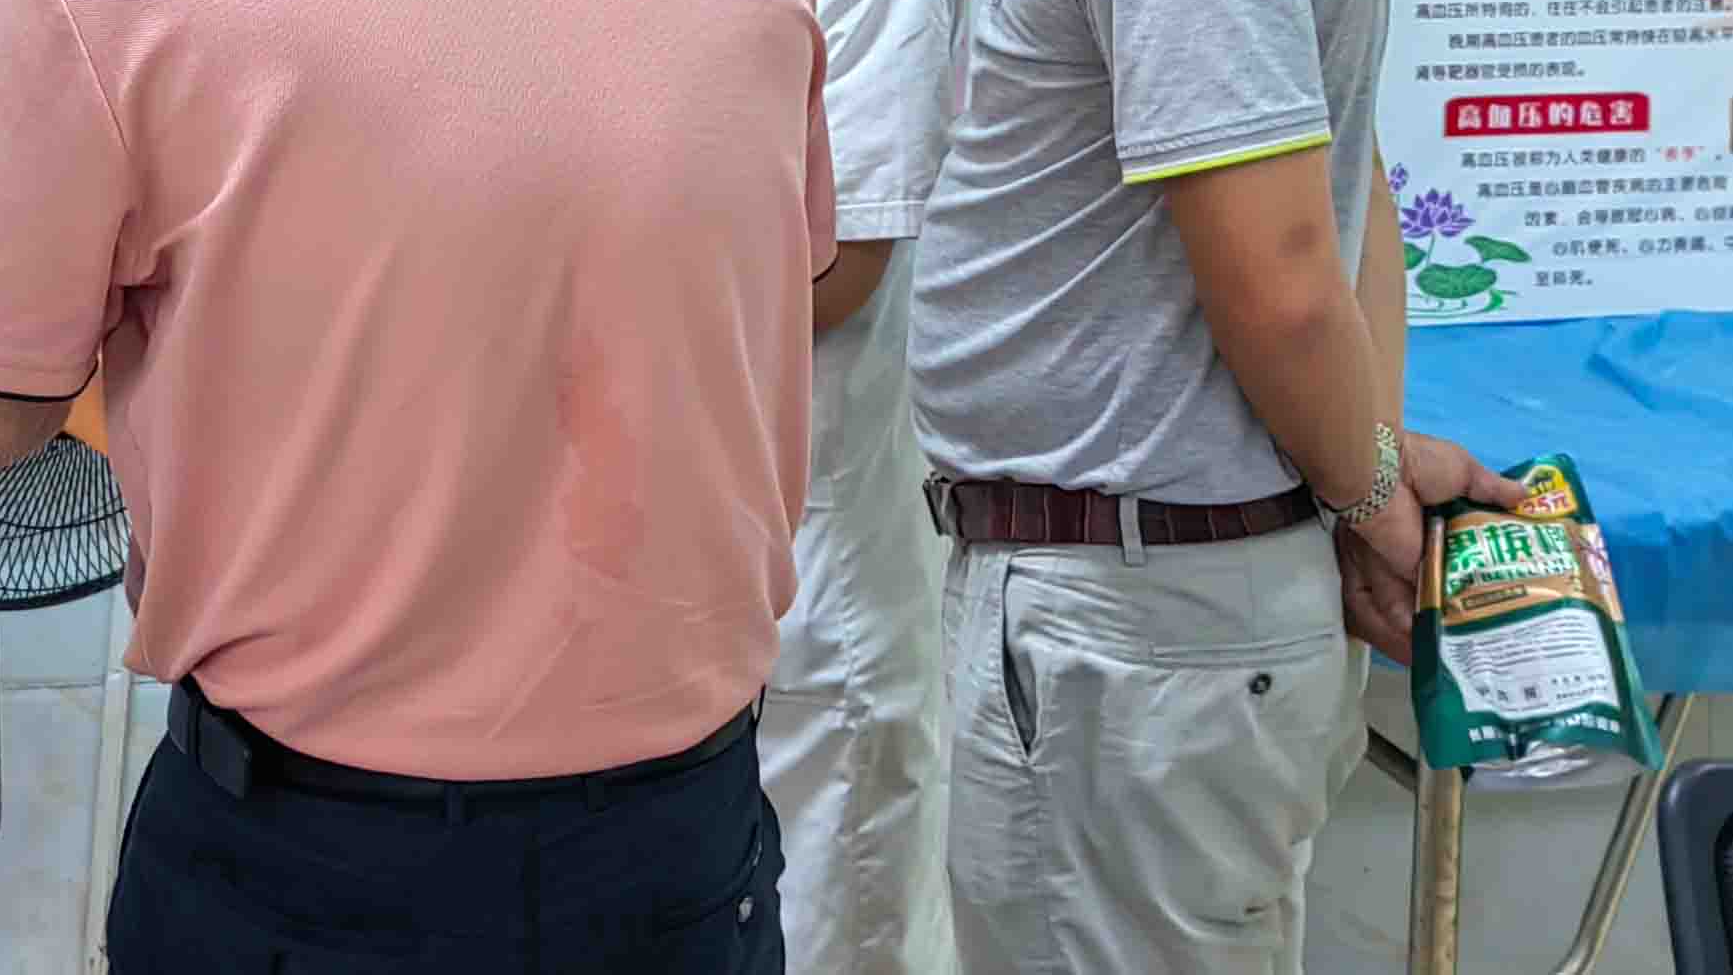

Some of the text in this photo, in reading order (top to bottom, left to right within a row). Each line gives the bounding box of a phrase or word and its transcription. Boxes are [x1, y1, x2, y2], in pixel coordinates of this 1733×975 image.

[1458, 99, 1634, 130] 高血压的危害
